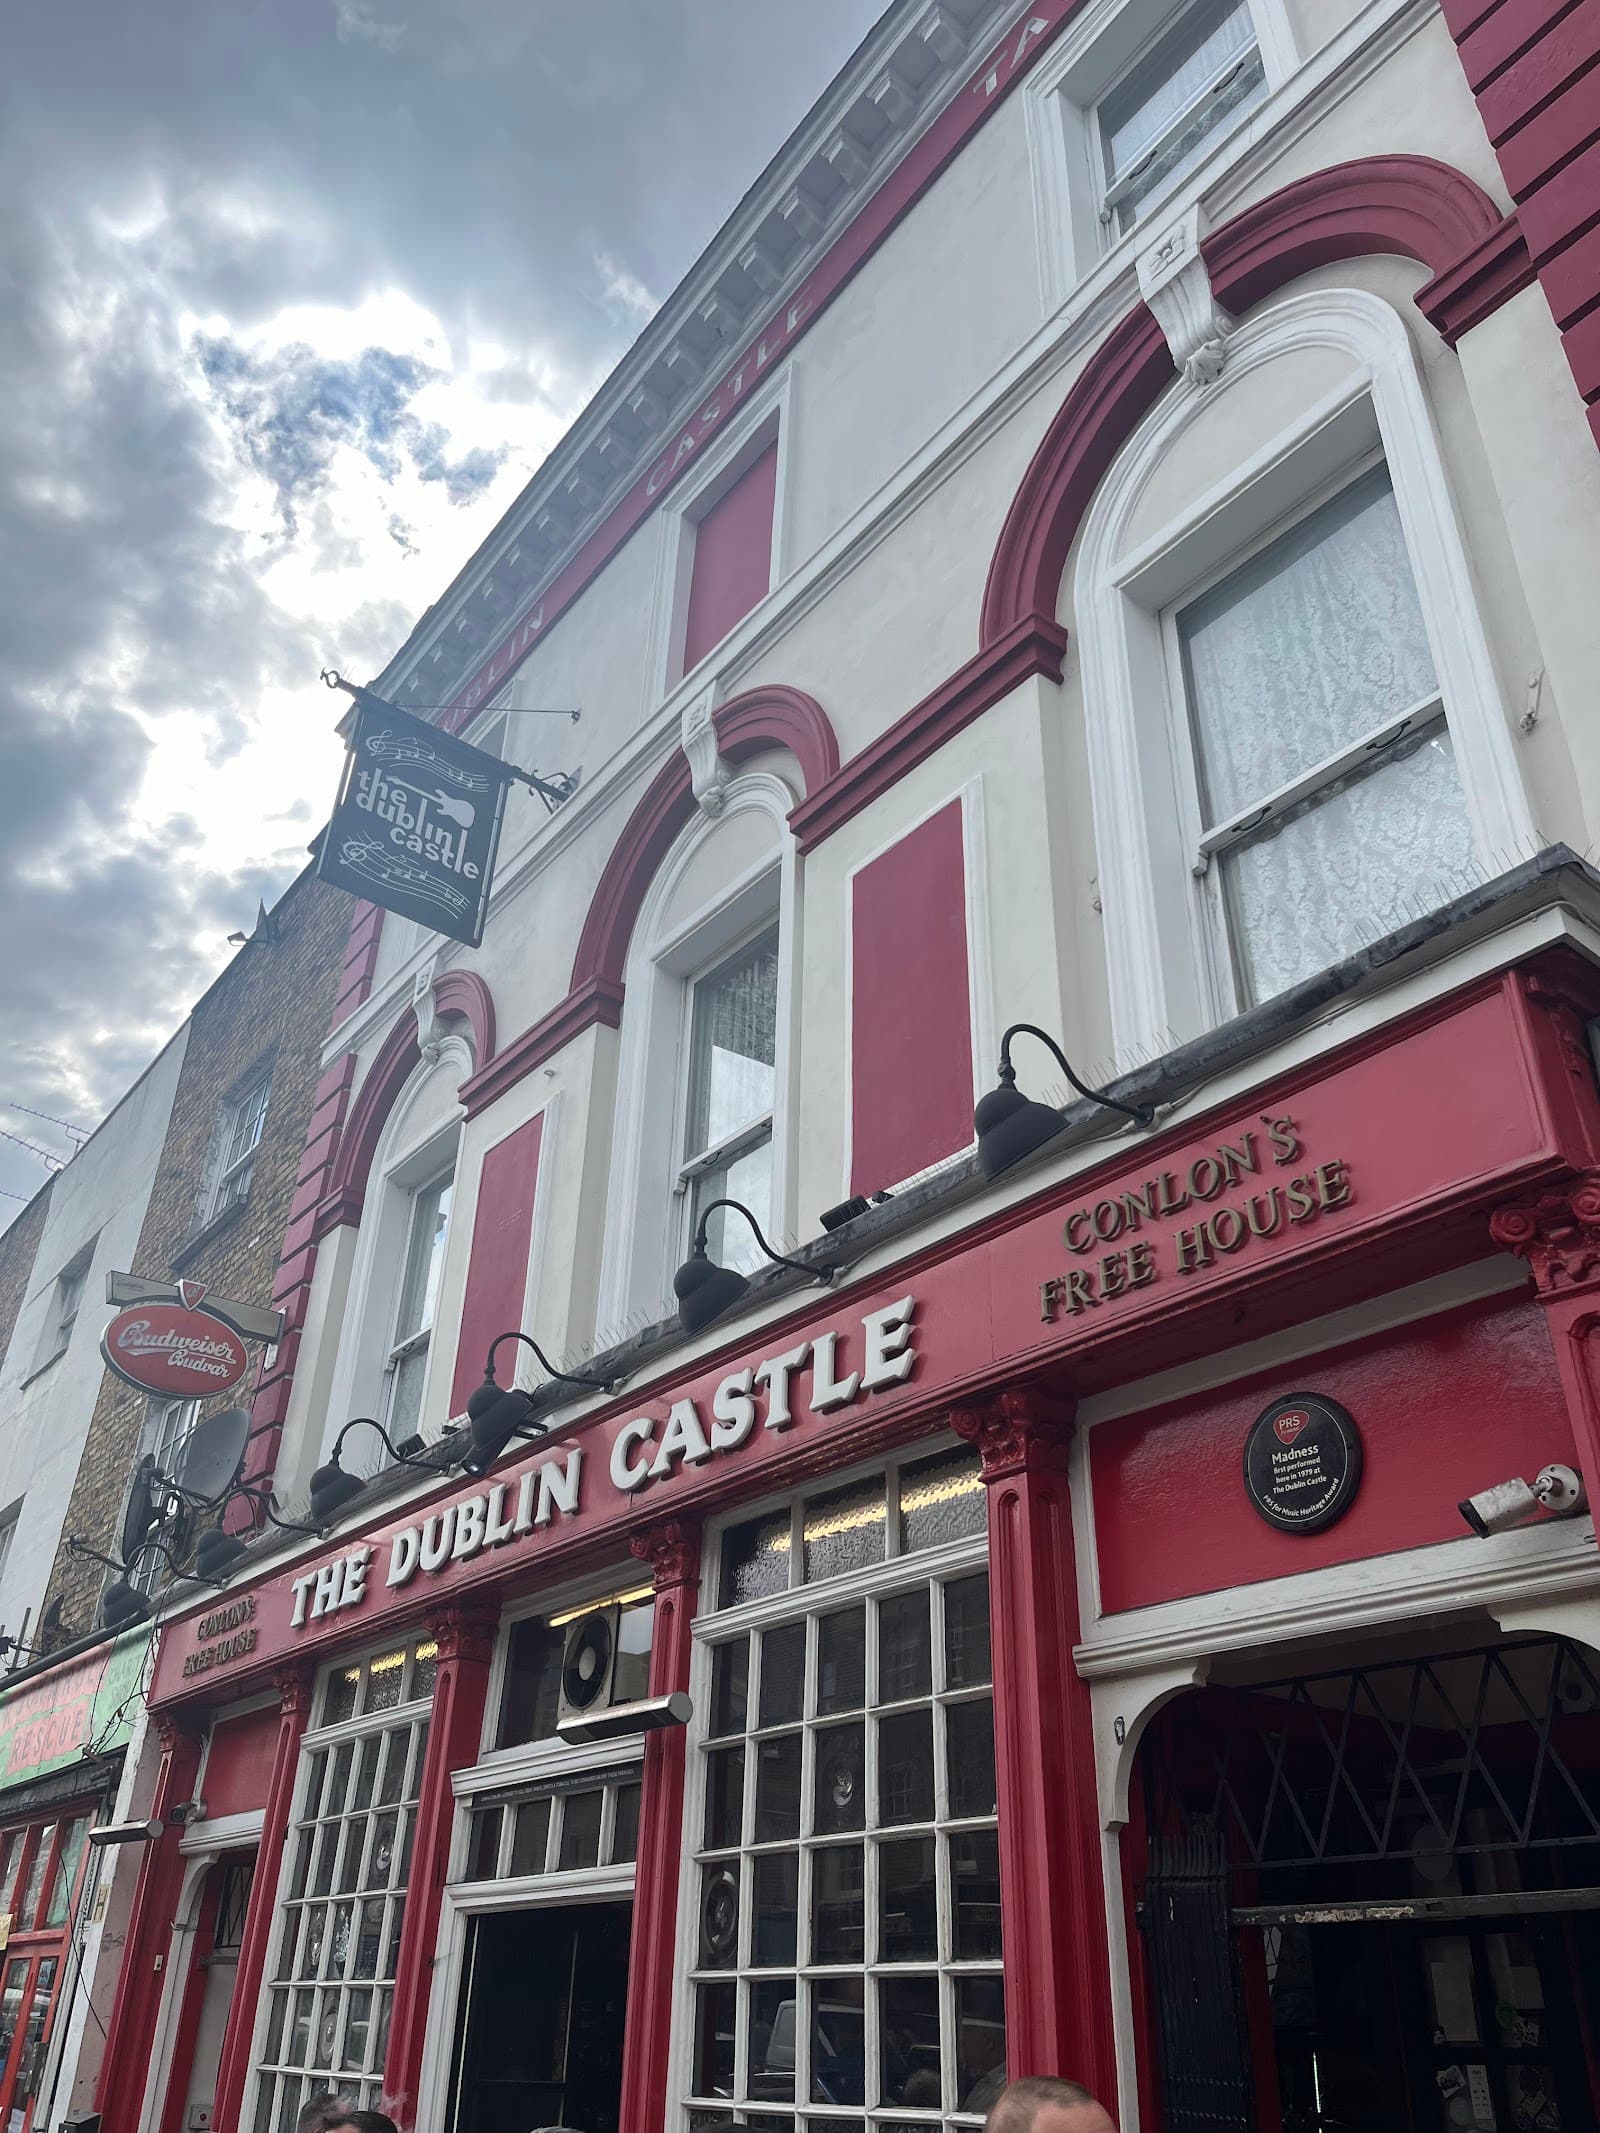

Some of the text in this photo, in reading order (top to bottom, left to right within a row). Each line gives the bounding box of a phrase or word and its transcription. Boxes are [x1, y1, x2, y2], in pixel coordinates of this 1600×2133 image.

[443, 16, 1049, 733] UBLIN CASTLE TA
[357, 768, 407, 805] the
[356, 784, 453, 846] dublin
[390, 827, 479, 879] castle
[1062, 1115, 1301, 1253] CONLON'S
[1039, 1158, 1351, 1323] FREE HOUSE
[118, 1320, 236, 1362] Budweiser
[168, 1348, 231, 1378] Budvar
[1279, 1415, 1301, 1430] PRS
[290, 1295, 917, 1628] THE DUBLIN CASTLE
[1271, 1444, 1320, 1465] Madness
[1273, 1456, 1321, 1475] first performed
[1298, 1468, 1313, 1478] 1979
[1271, 1503, 1282, 1512] for
[1281, 1507, 1300, 1517] Music
[1300, 1498, 1327, 1516] Heritage
[1324, 1477, 1339, 1501] Award
[1273, 1475, 1327, 1494] The Dublin Castle
[215, 1628, 257, 1666] HOUSE
[11, 1710, 83, 1767] RESCUE
